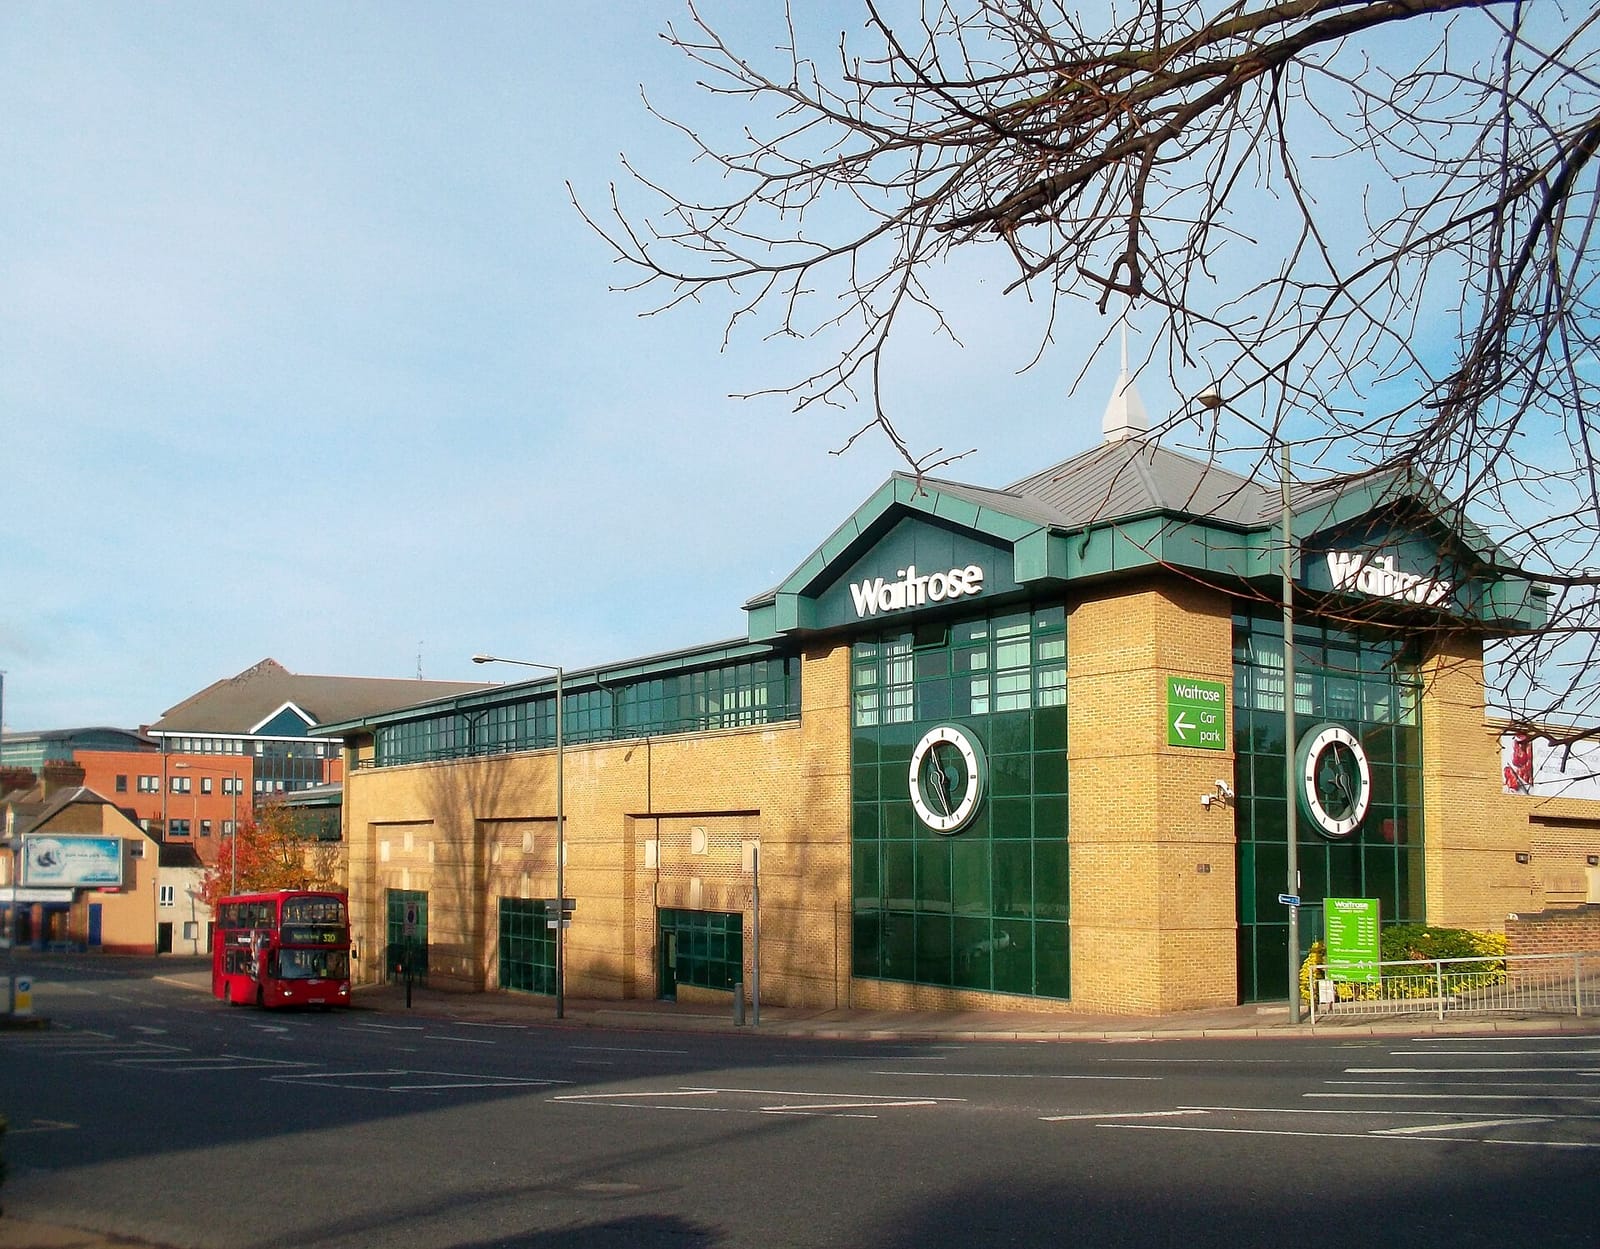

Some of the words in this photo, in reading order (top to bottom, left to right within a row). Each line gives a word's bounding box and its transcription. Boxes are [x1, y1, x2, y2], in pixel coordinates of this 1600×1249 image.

[849, 565, 984, 618] Waitrose
[1173, 683, 1220, 702] Waitrose
[1200, 711, 1216, 724] Car
[1200, 729, 1220, 743] park
[323, 934, 336, 943] 320
